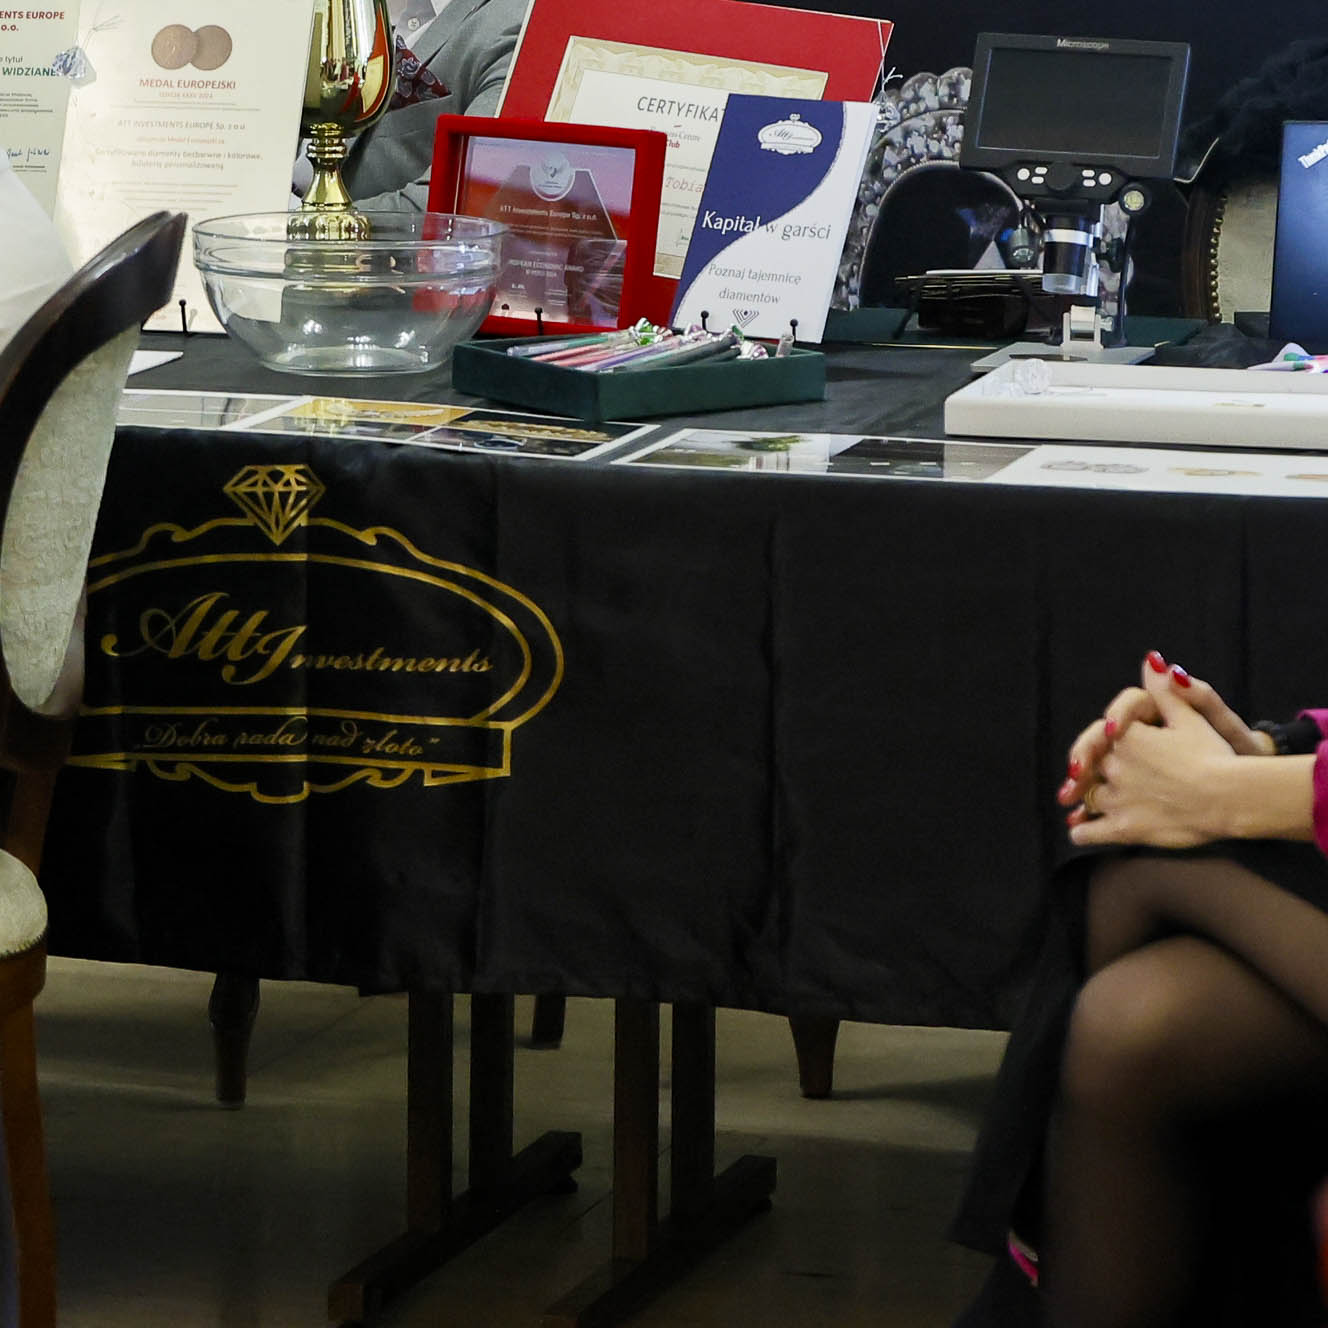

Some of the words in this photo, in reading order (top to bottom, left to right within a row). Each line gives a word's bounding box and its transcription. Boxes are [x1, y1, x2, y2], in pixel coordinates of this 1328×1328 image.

[26, 12, 65, 20] EUROPE
[1056, 37, 1110, 51] Microscope
[139, 79, 174, 89] MEDAL
[176, 80, 237, 90] EUROPEJSKI
[637, 96, 725, 122] CERTYFIKA
[763, 222, 778, 233] w
[781, 223, 832, 240] garści
[708, 263, 745, 281] Poznaj
[747, 268, 802, 286] tajemnicę
